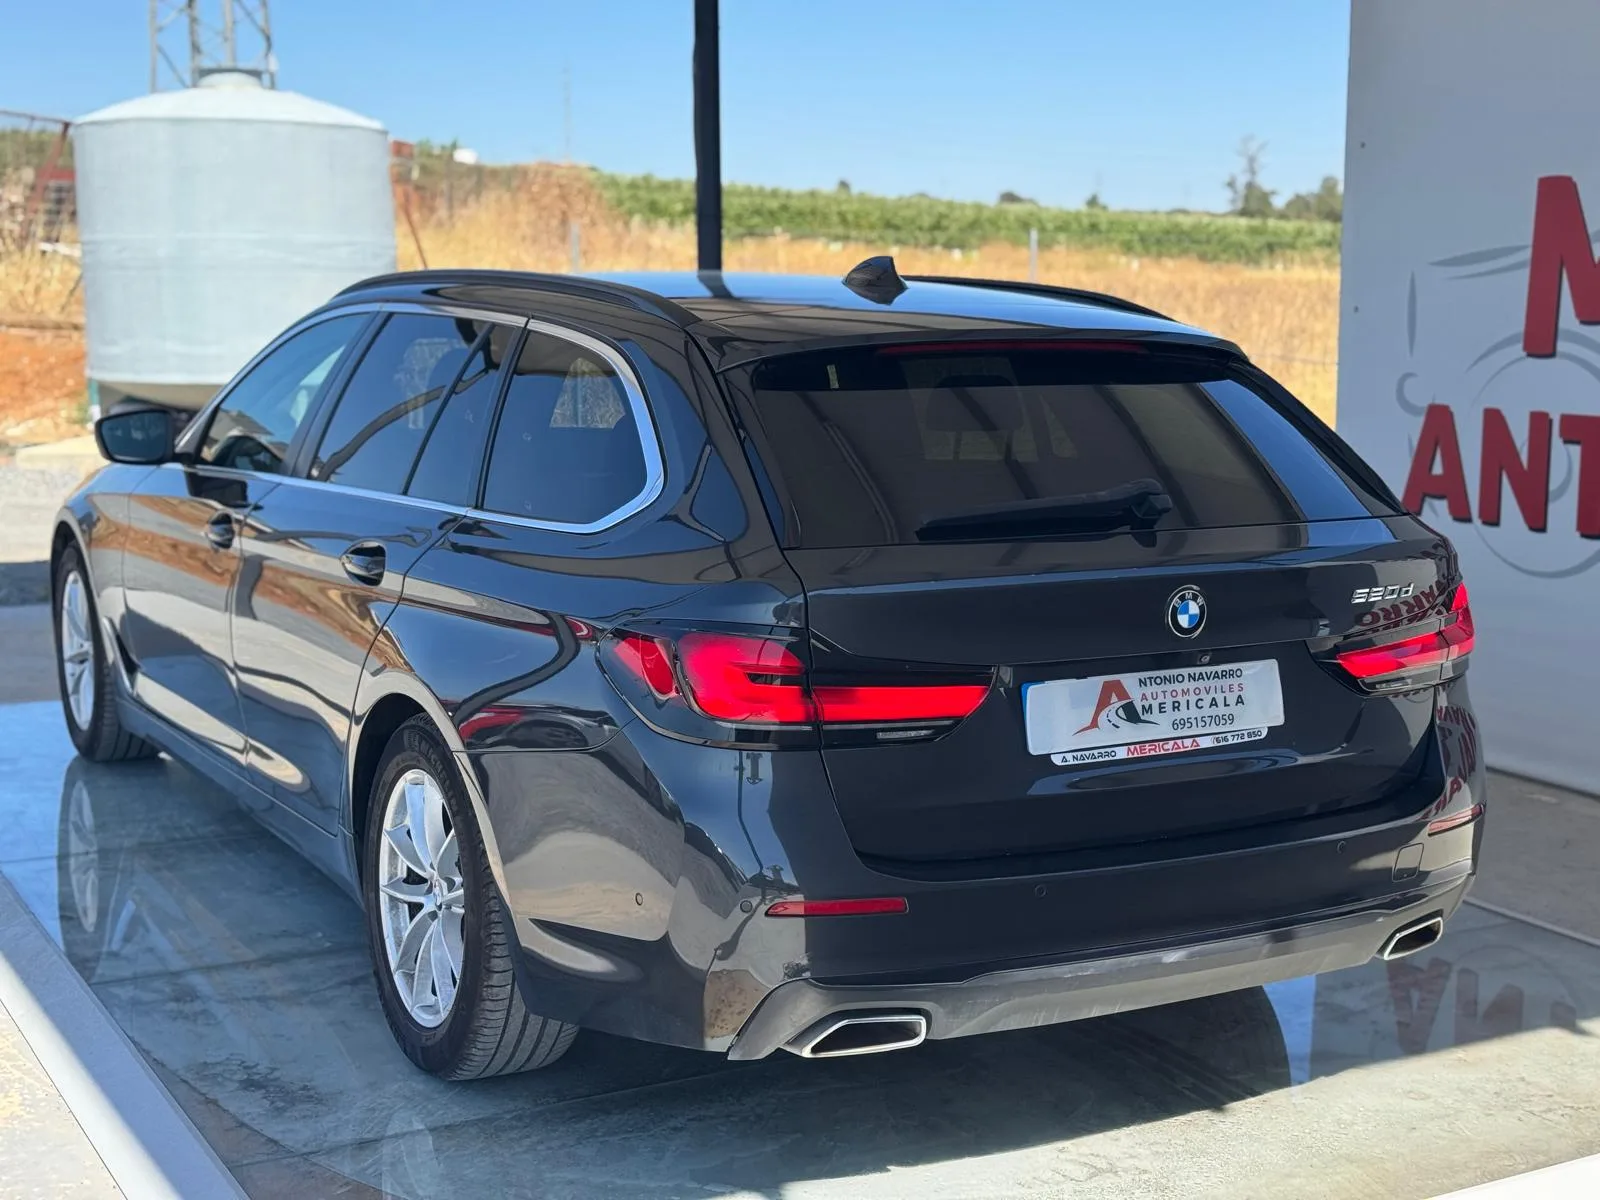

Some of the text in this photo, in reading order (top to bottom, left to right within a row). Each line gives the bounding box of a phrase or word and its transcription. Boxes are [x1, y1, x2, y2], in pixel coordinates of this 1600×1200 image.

[1351, 582, 1414, 604] 520d
[1187, 668, 1243, 682] NAVARRO
[1140, 683, 1244, 702] AUTOMOVILES
[1141, 694, 1245, 716] MERICALA
[1171, 713, 1235, 731] 695157059
[1061, 755, 1071, 763] A.
[1072, 750, 1117, 762] NAVARRO
[1126, 739, 1200, 757] MERICALA
[1230, 733, 1246, 742] 772
[1246, 730, 1263, 739] 850
